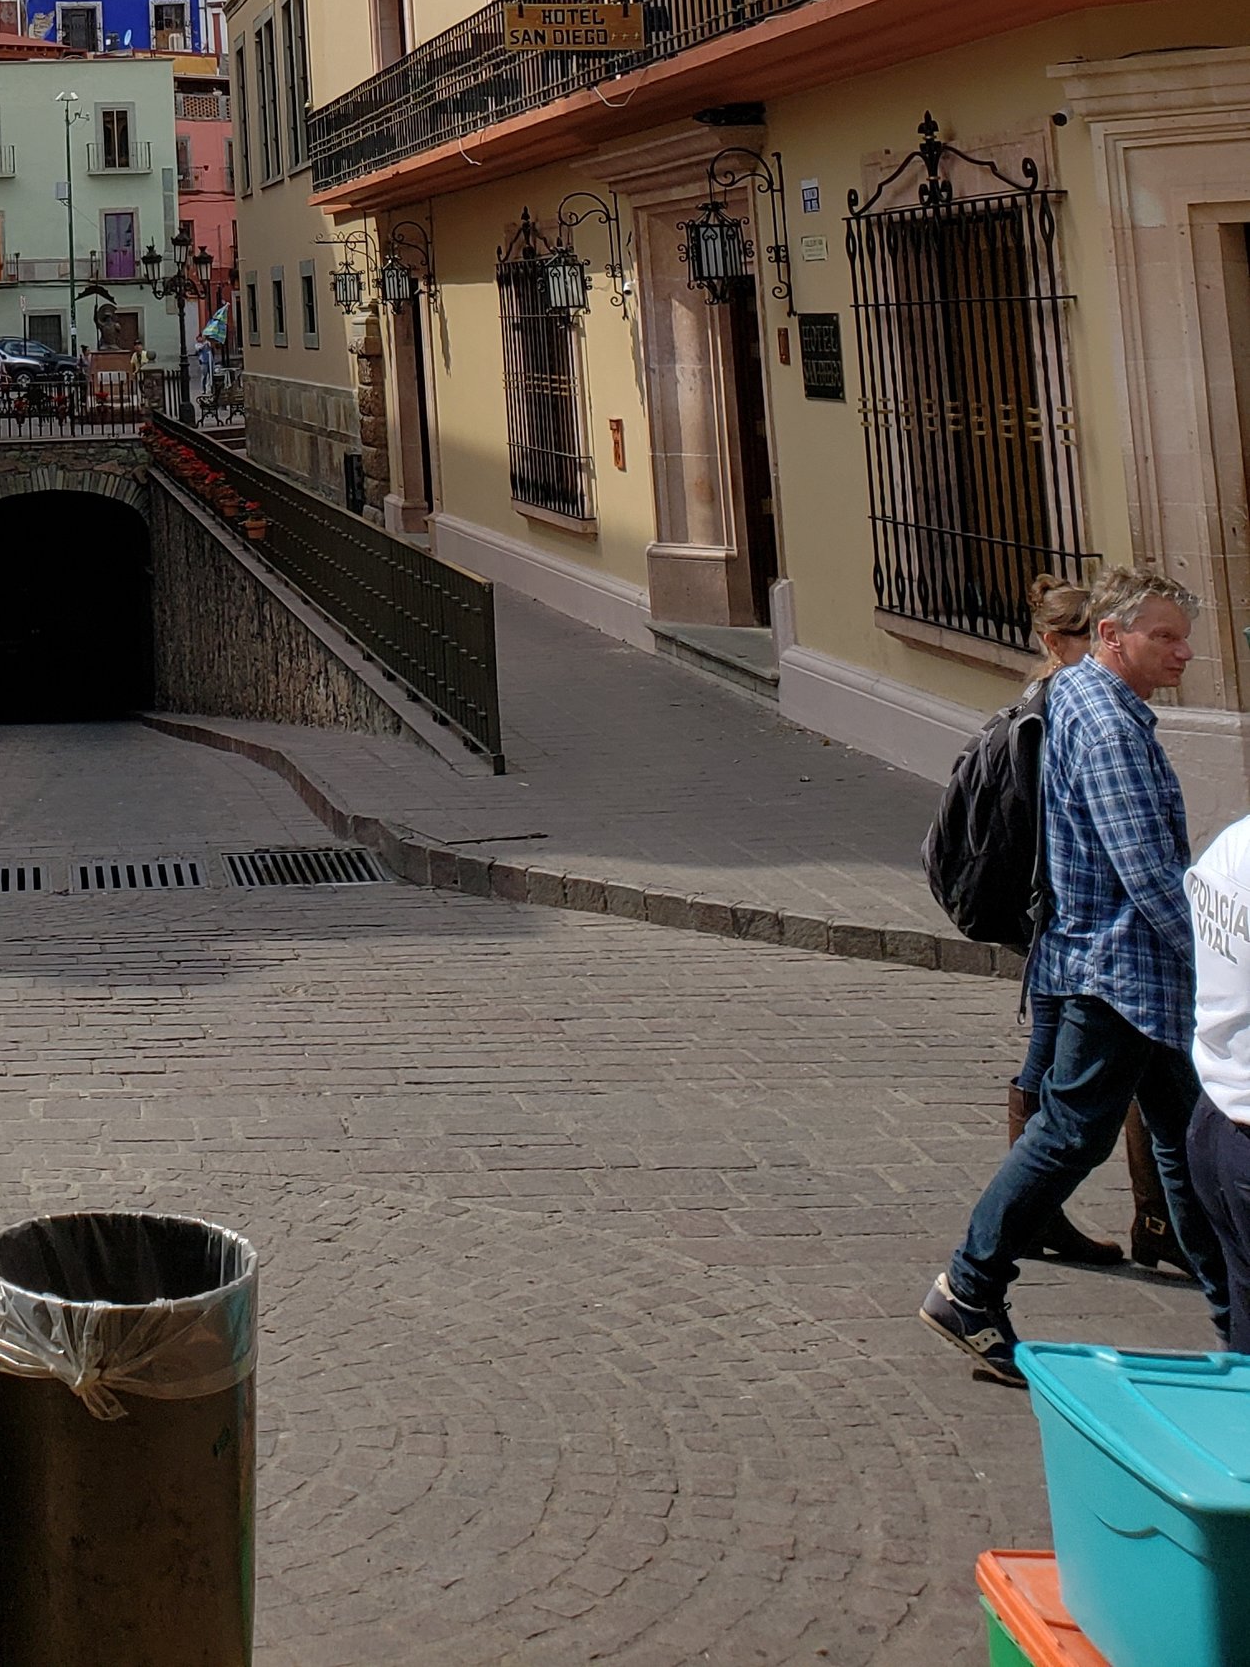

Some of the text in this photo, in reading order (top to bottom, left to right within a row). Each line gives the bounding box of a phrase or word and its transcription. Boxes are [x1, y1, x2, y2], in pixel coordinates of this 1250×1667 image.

[541, 8, 605, 25] HOTEL
[510, 29, 608, 45] SAN DIEGO
[801, 325, 838, 352] HOTEL
[1190, 877, 1250, 943] POLICÍA
[1196, 911, 1238, 965] VIAL
